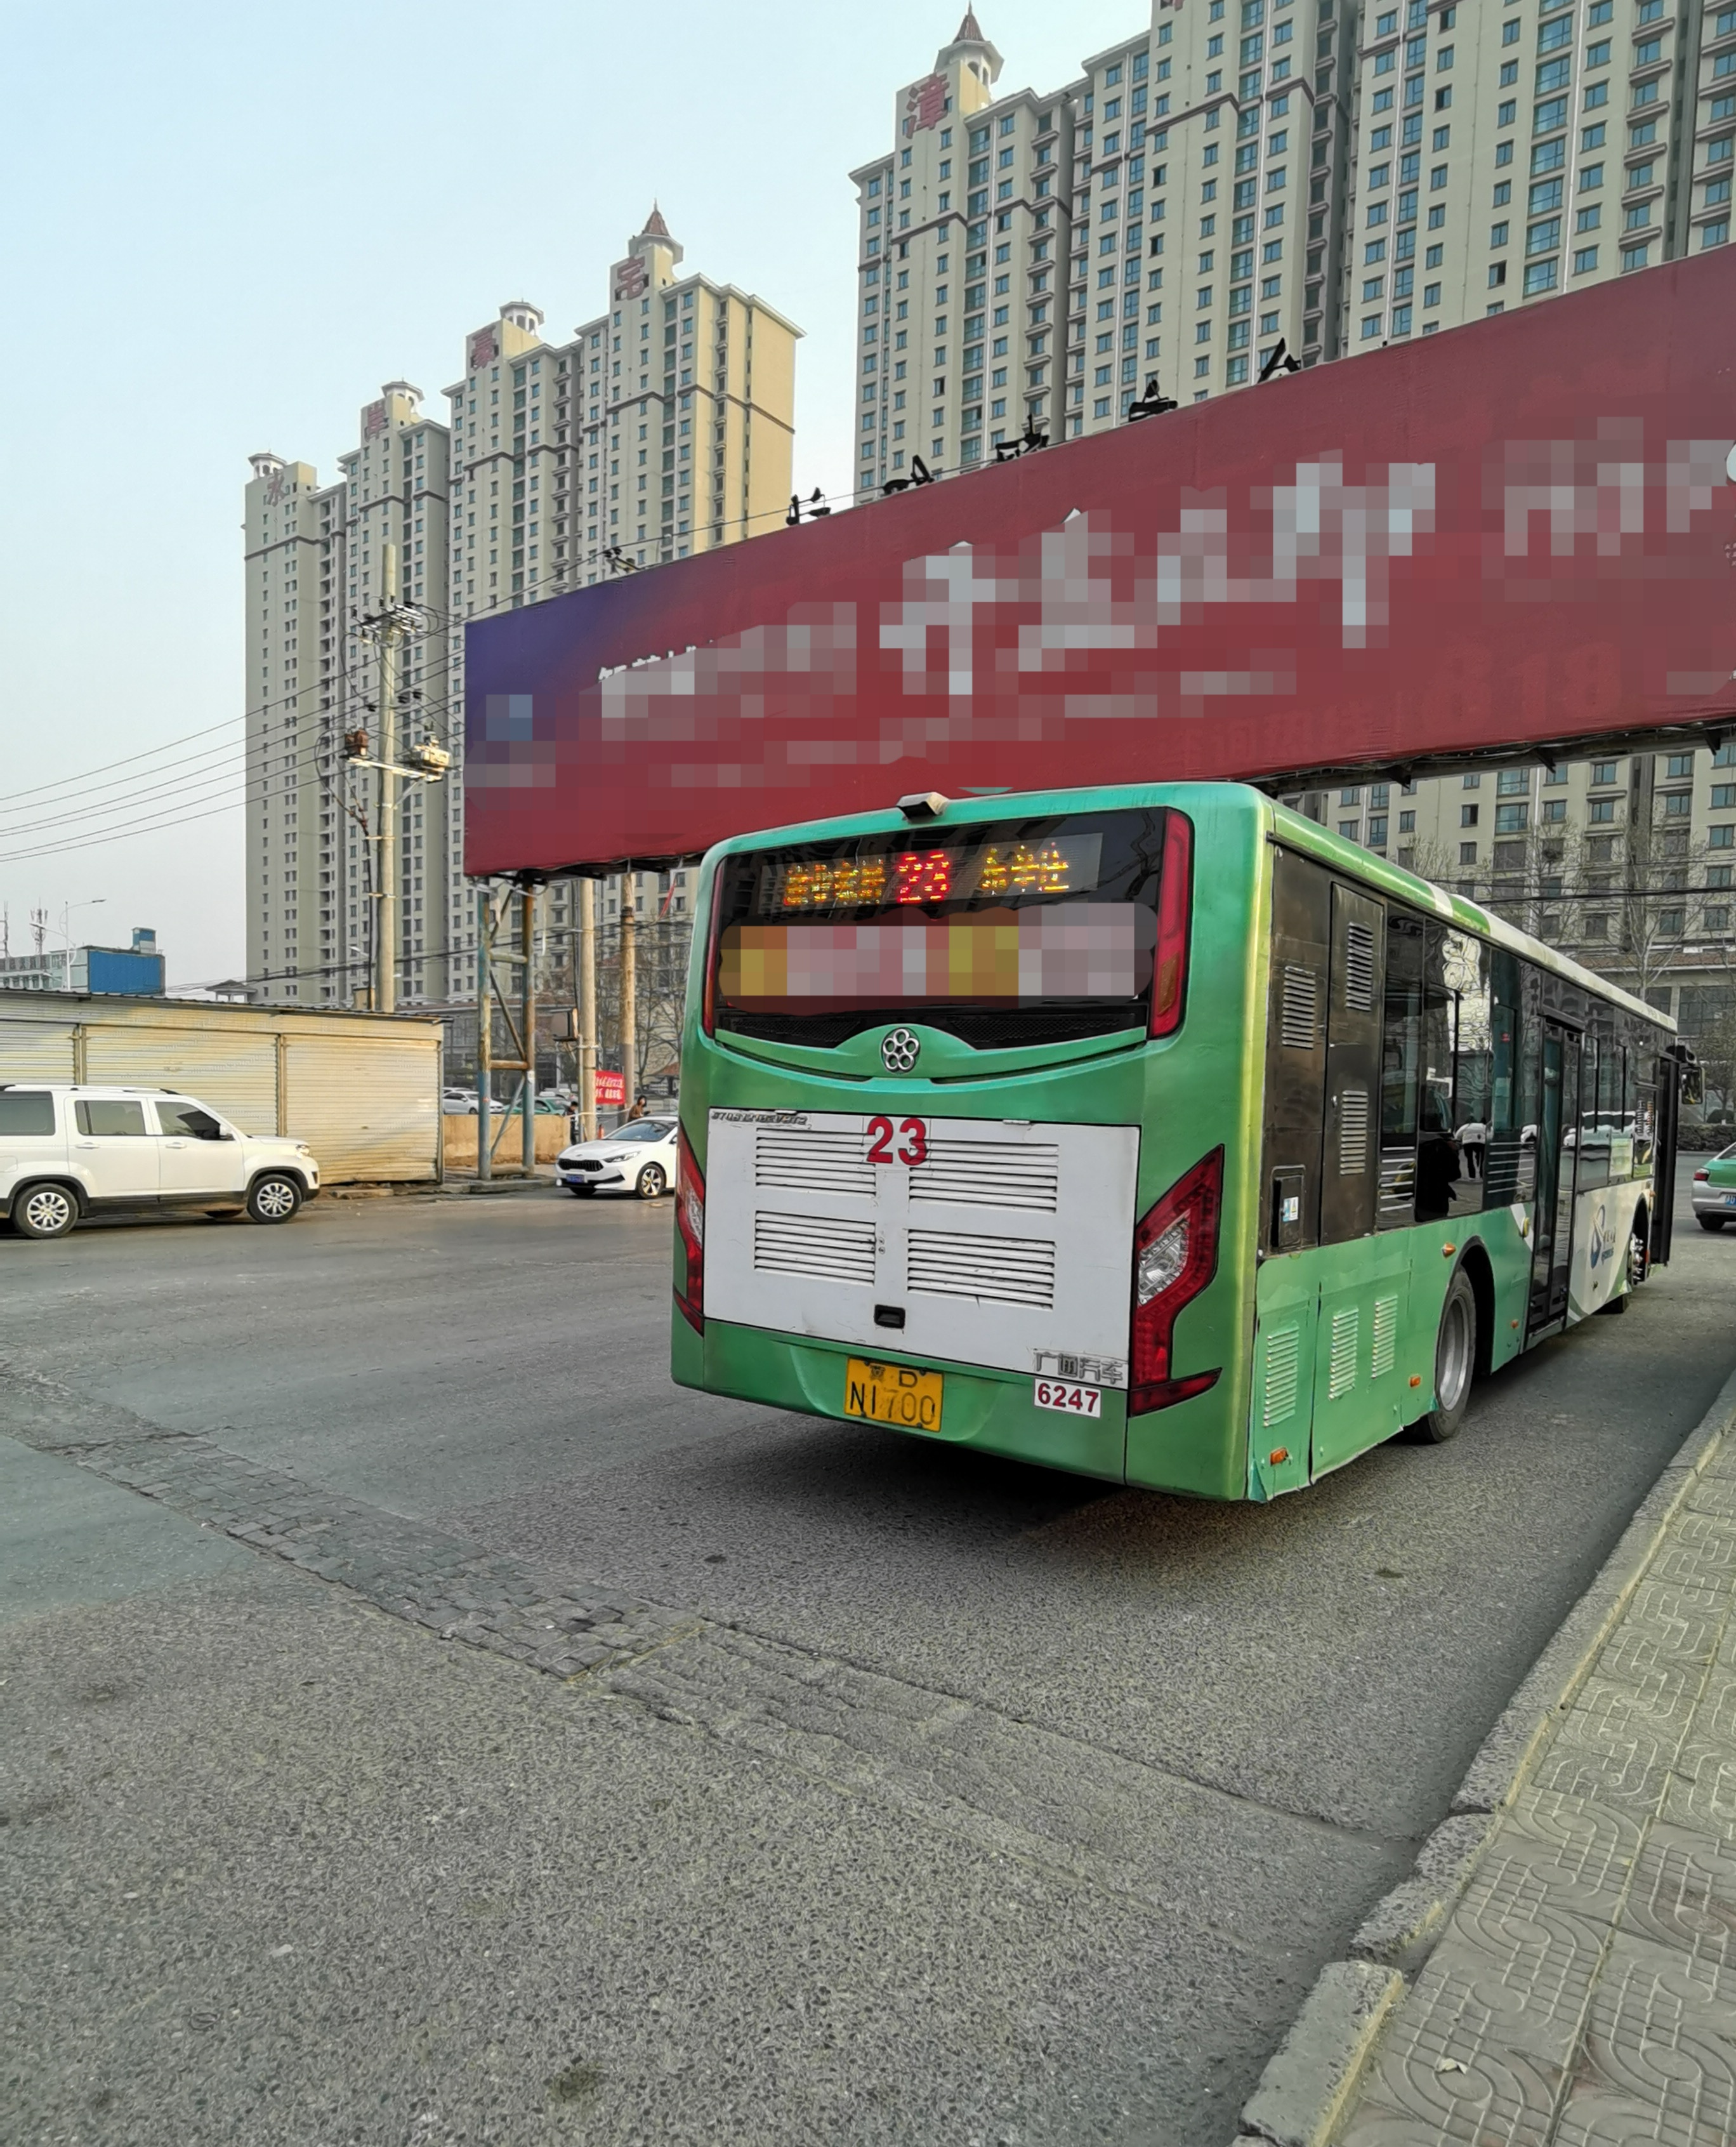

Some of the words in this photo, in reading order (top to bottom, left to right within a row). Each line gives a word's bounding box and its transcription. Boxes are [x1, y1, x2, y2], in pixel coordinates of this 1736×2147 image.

[905, 72, 950, 140] 漳
[866, 1116, 927, 1166] 23
[850, 1381, 935, 1425] N1700
[1037, 1382, 1100, 1413] 6247
